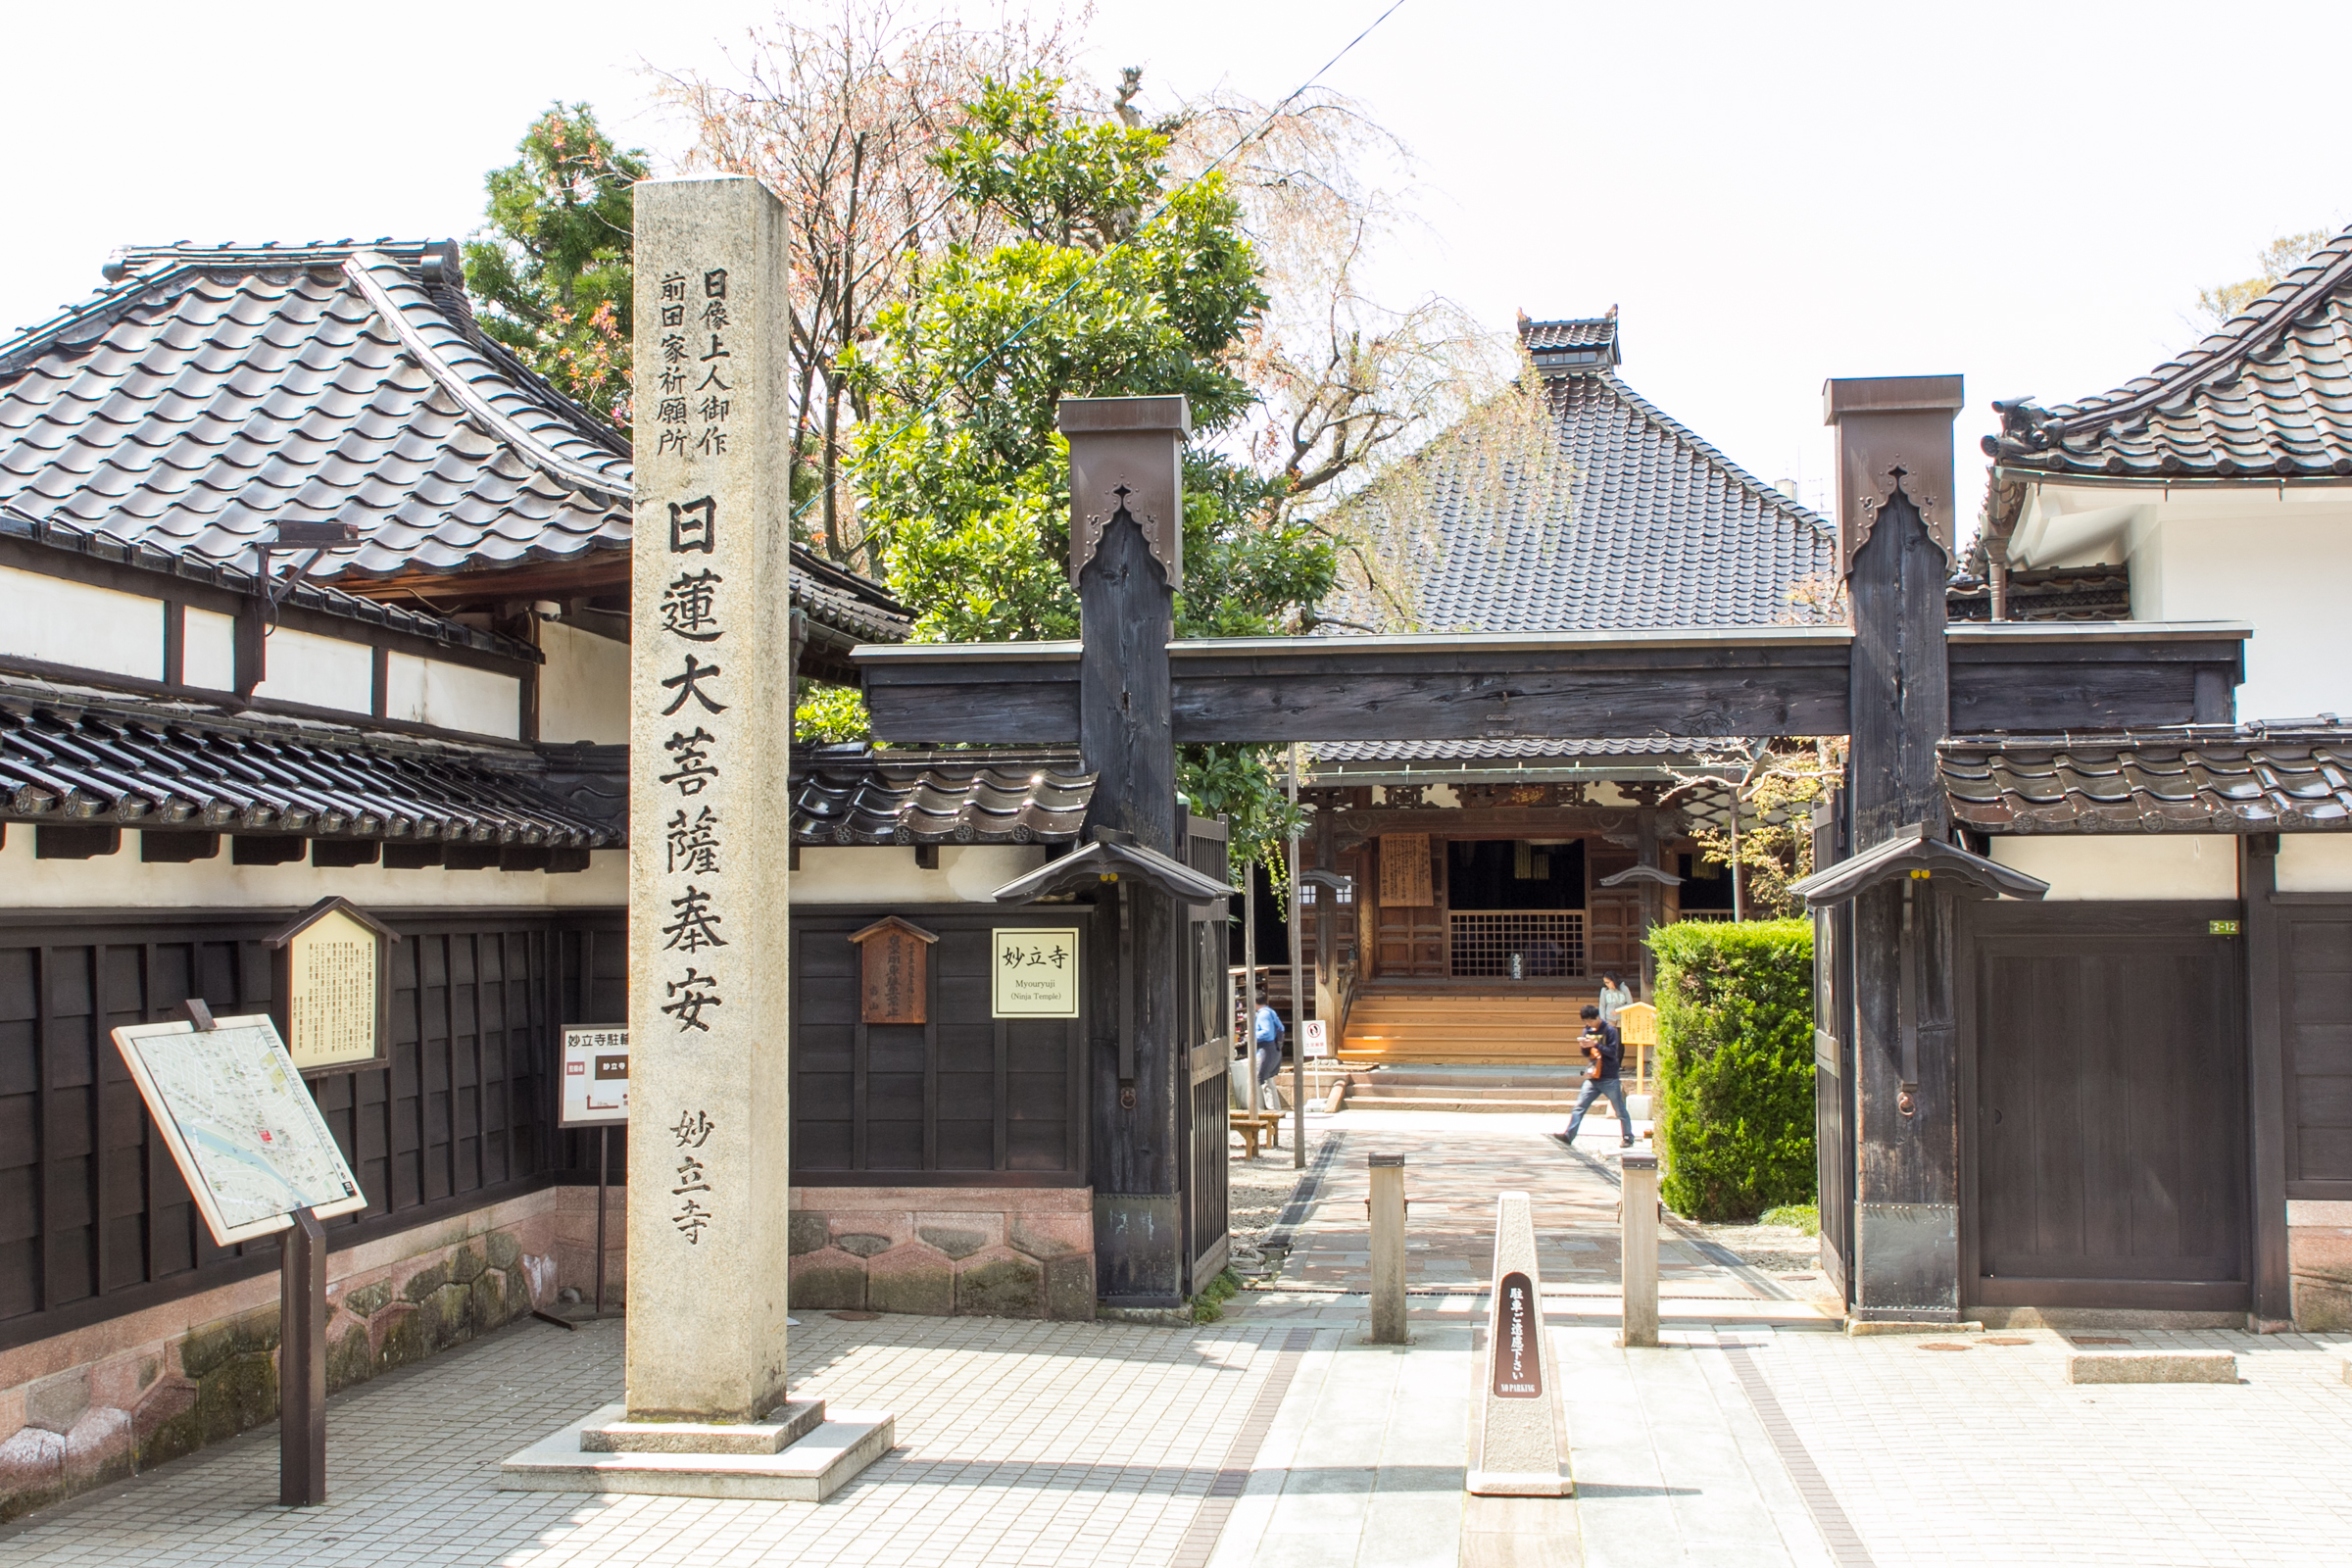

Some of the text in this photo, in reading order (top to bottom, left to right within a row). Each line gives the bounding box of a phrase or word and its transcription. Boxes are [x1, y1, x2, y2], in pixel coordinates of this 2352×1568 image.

[656, 272, 689, 459] 前田家祈願所
[696, 267, 733, 458] 日像上人御作
[660, 495, 729, 1034] 日蓮大菩薩奉安
[2214, 922, 2235, 931] 2-12
[1003, 945, 1069, 969] 妙立寺
[1015, 979, 1055, 989] Myouryuji
[1010, 992, 1061, 1001] (Ninja Temple)
[669, 1109, 715, 1246] 妙立寺
[1509, 1287, 1524, 1380] 駐車ご遠慮下さい
[1509, 1384, 1536, 1393] PARKING
